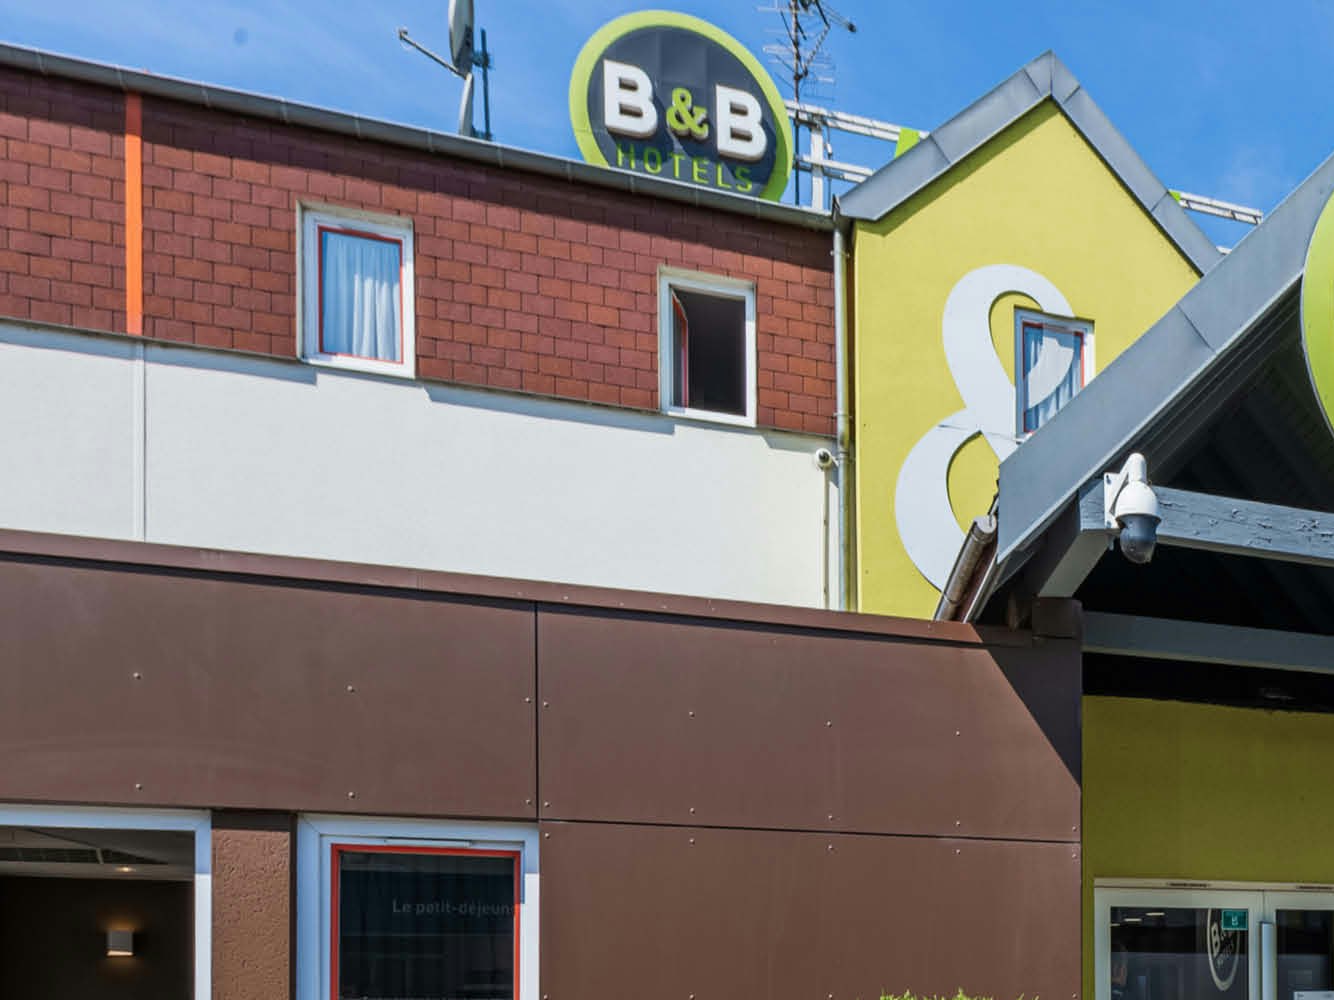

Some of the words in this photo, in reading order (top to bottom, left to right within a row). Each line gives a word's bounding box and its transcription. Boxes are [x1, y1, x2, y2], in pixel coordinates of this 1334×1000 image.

[603, 59, 767, 162] B&B
[616, 143, 753, 192] HOTELS
[415, 899, 514, 918] petit-déjeun
